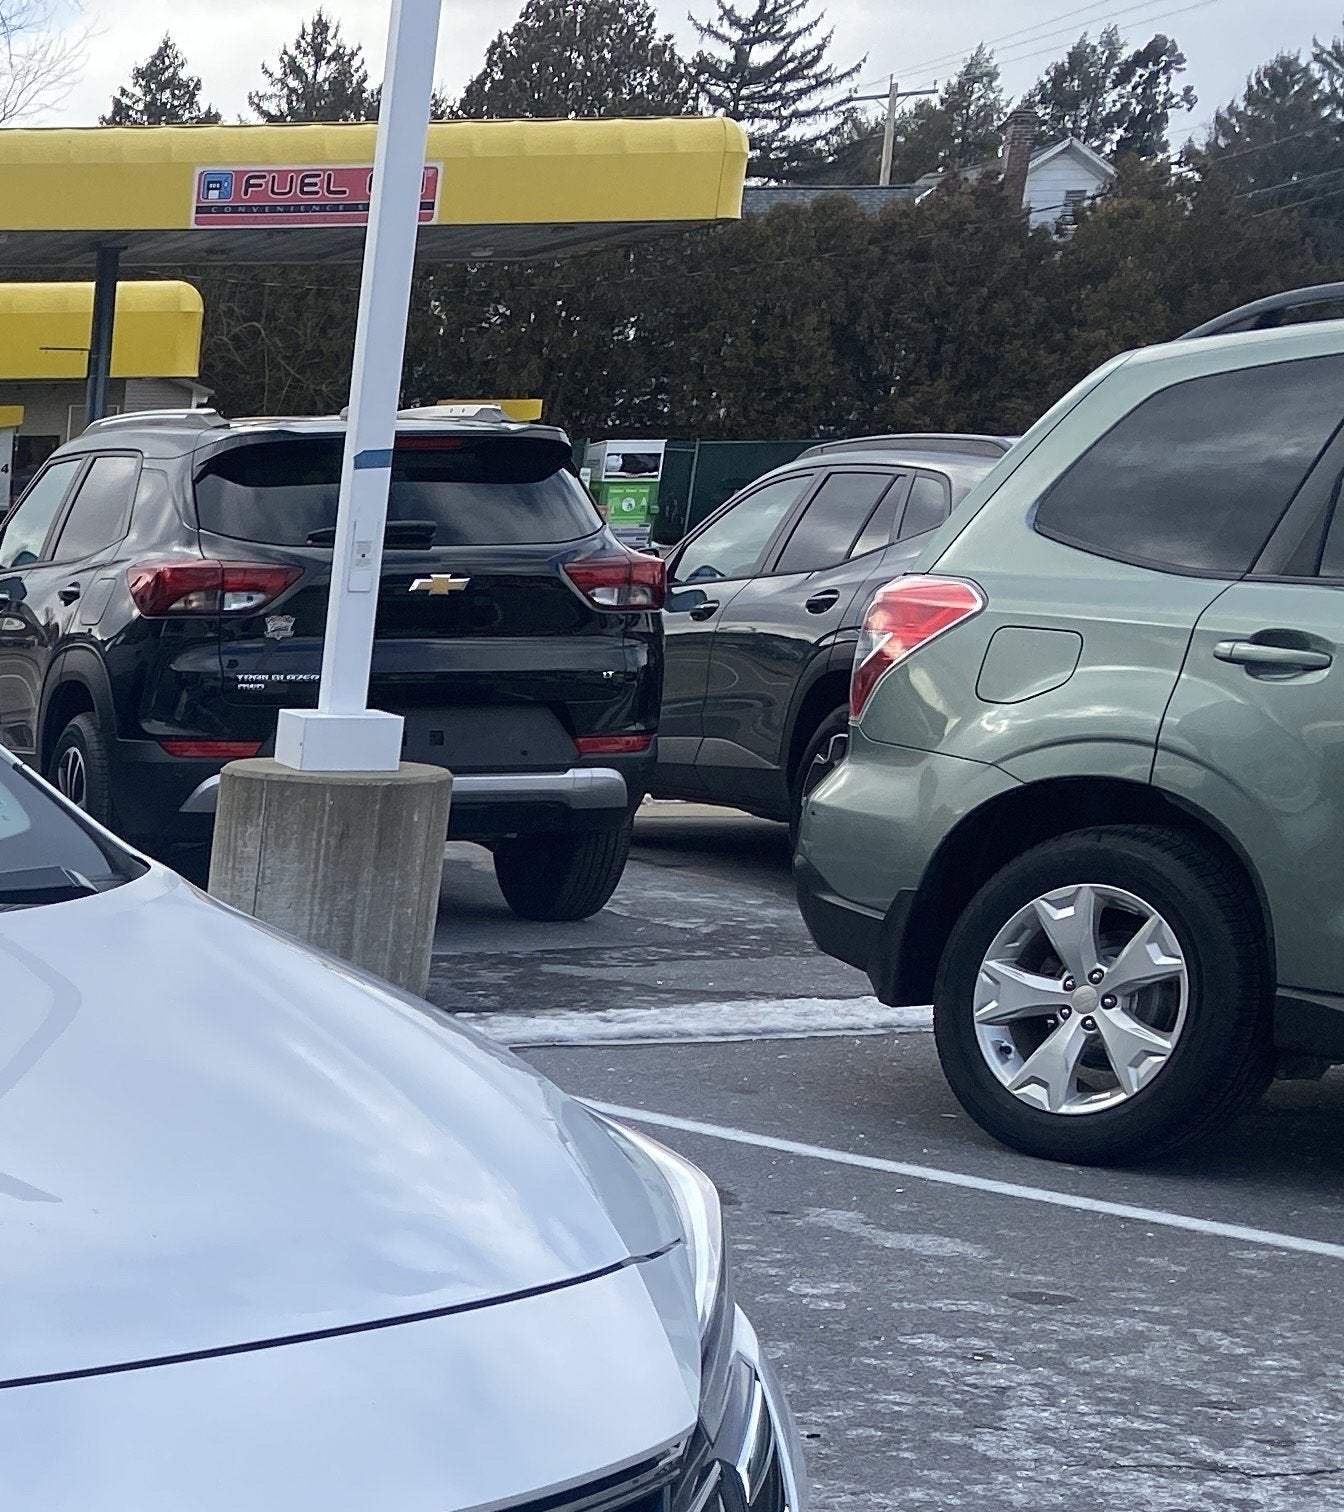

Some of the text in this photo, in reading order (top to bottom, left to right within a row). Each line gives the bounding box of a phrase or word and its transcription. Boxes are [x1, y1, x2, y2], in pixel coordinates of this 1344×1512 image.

[241, 171, 349, 199] FUEL
[210, 204, 345, 213] CONVENIENCE
[0, 463, 10, 474] 4
